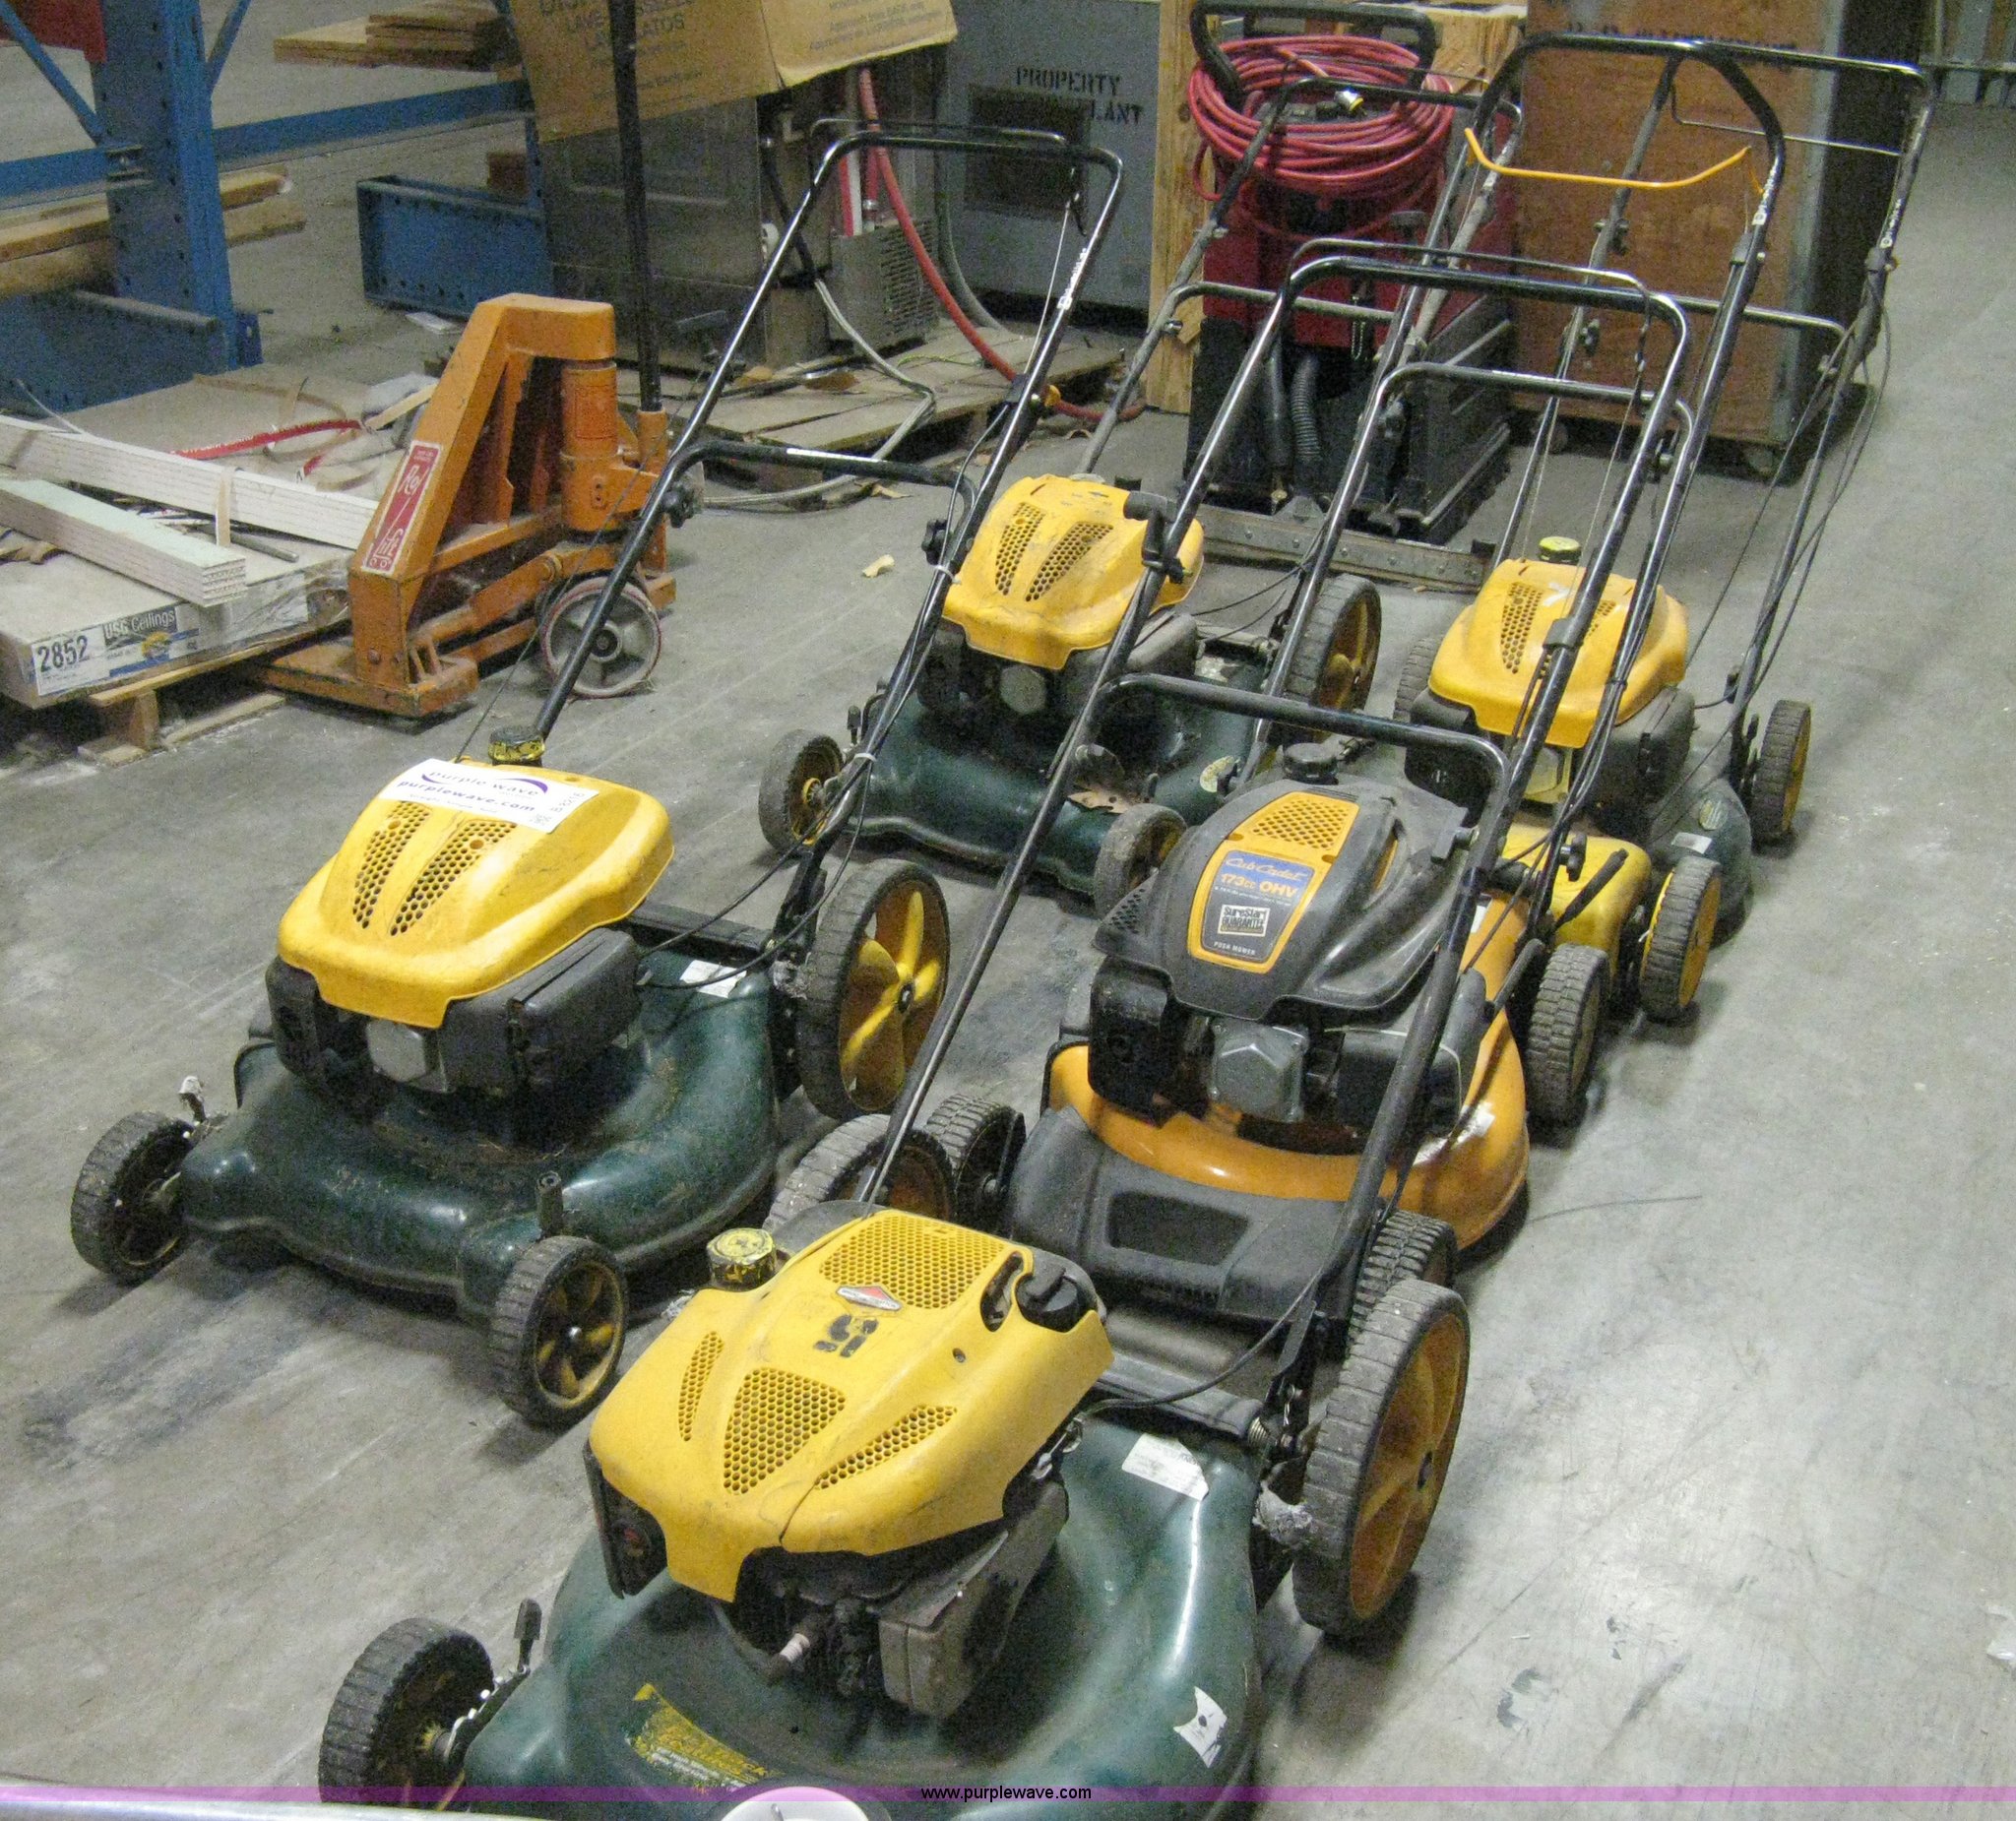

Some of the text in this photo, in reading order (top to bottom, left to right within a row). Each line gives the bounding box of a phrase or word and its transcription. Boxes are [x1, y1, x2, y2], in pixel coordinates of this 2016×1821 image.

[1016, 66, 1121, 96] PROPERTY
[104, 609, 175, 640] USG Ceilings
[36, 635, 91, 673] 2852
[397, 781, 536, 812] purplewave.com
[492, 784, 538, 796] wave
[1259, 880, 1298, 898] OHV
